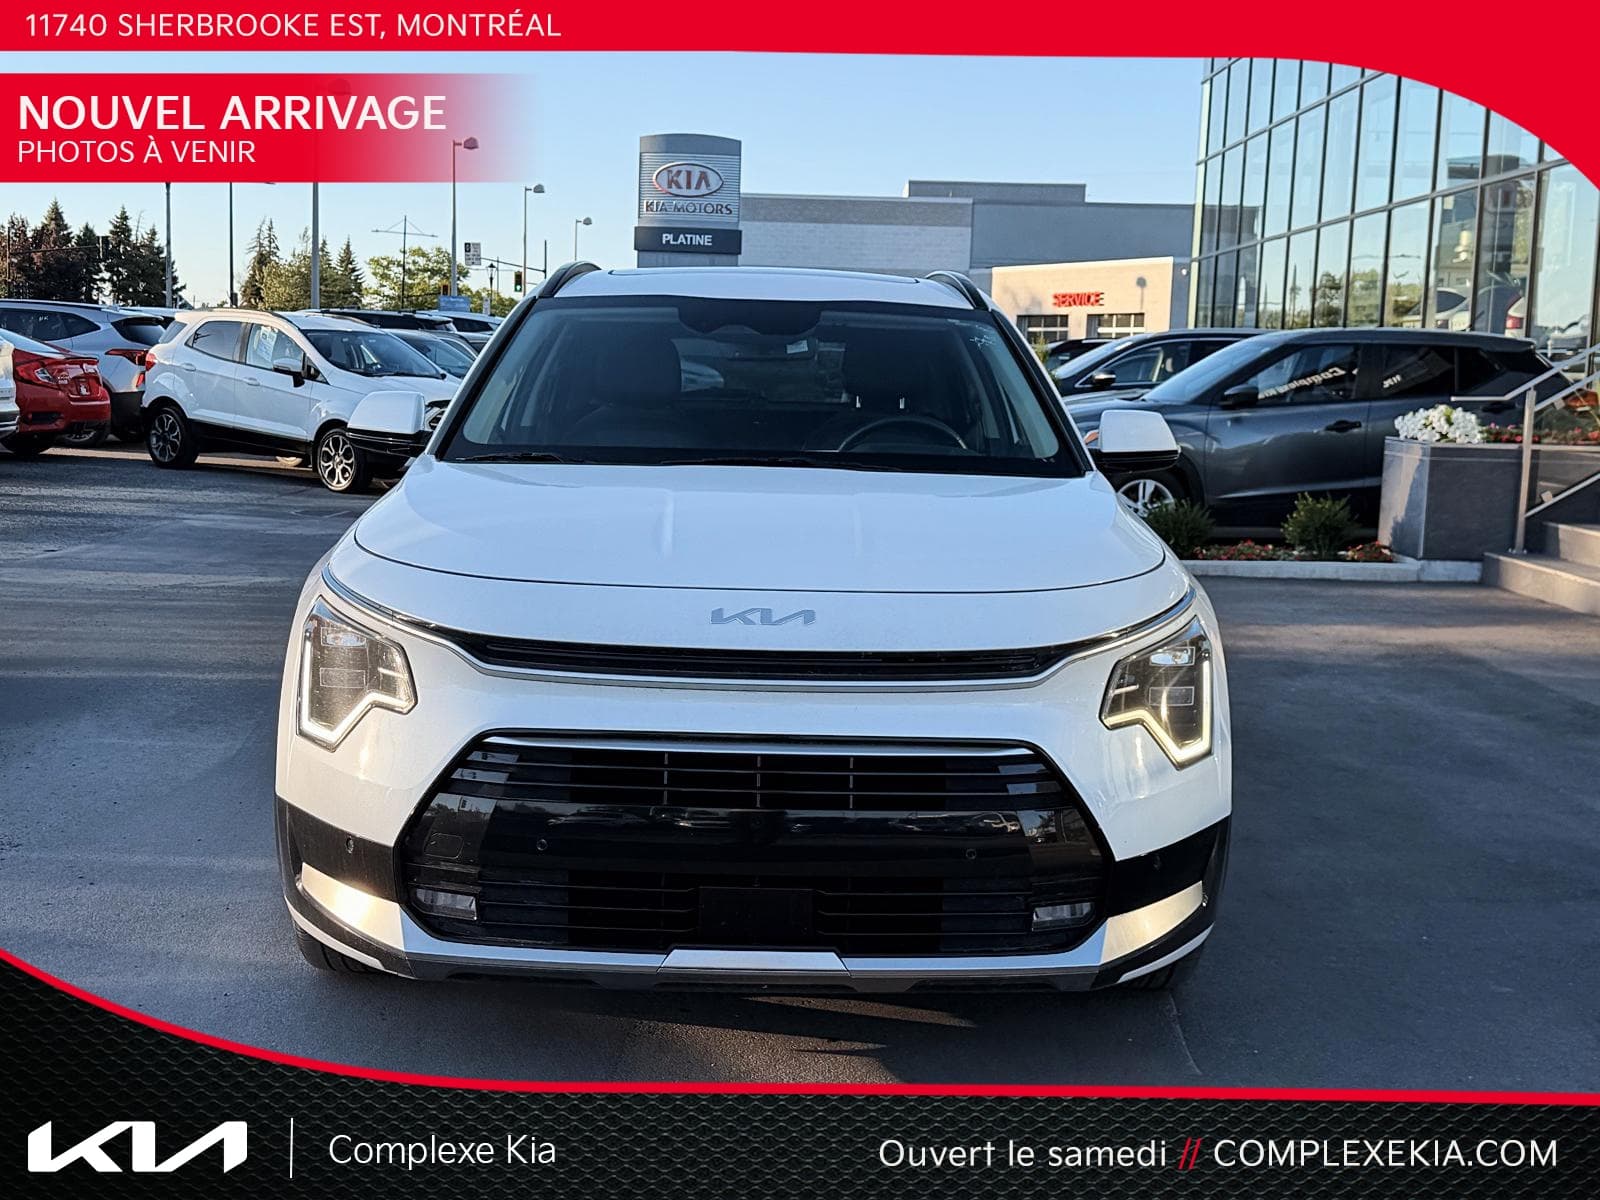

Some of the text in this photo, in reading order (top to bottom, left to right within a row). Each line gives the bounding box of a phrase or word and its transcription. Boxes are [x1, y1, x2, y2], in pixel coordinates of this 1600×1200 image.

[667, 169, 711, 190] KIA
[644, 200, 733, 215] KIA MOTORS
[662, 233, 713, 246] PLATINE
[1053, 292, 1104, 307] SERVICE
